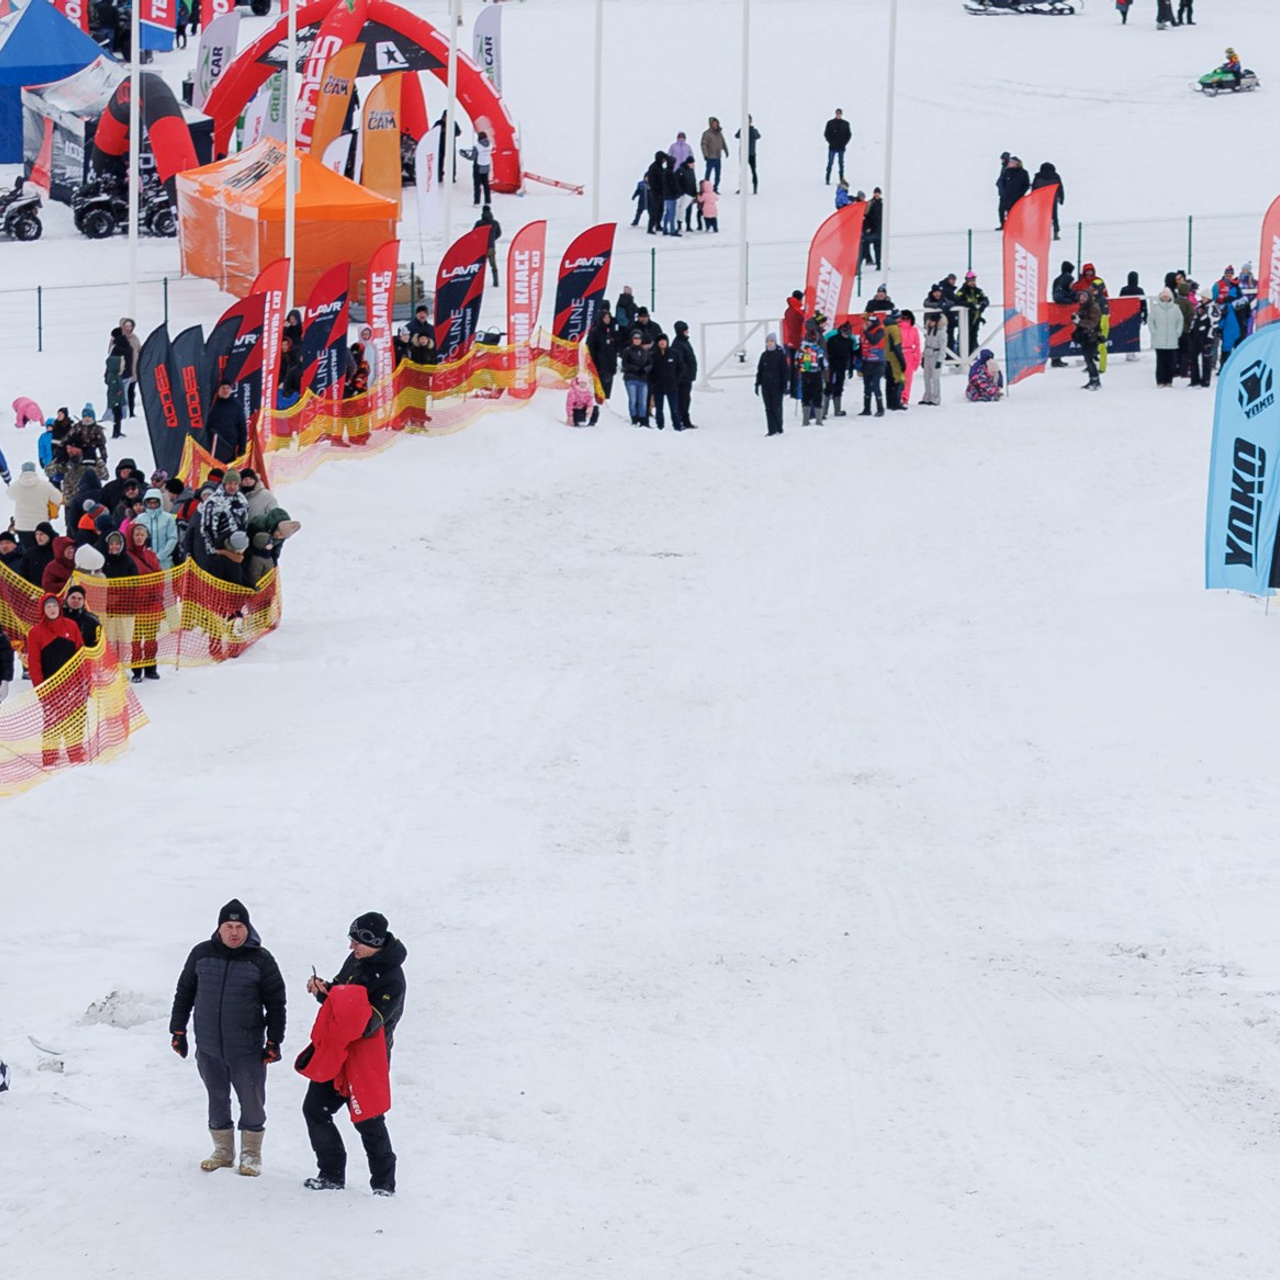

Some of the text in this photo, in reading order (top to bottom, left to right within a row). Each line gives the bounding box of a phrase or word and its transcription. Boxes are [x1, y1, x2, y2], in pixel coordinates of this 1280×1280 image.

[442, 264, 479, 278] LAVR
[515, 250, 529, 304] КЛАСС
[565, 257, 605, 269] LAVR
[815, 257, 834, 311] NOW
[1014, 243, 1027, 316] SNOW
[308, 301, 342, 318] LAVR
[371, 273, 387, 328] КЛАСС
[154, 364, 179, 428] AODES
[181, 365, 204, 429] AODES
[1244, 393, 1275, 420] YOKO
[1225, 437, 1267, 574] YOKO
